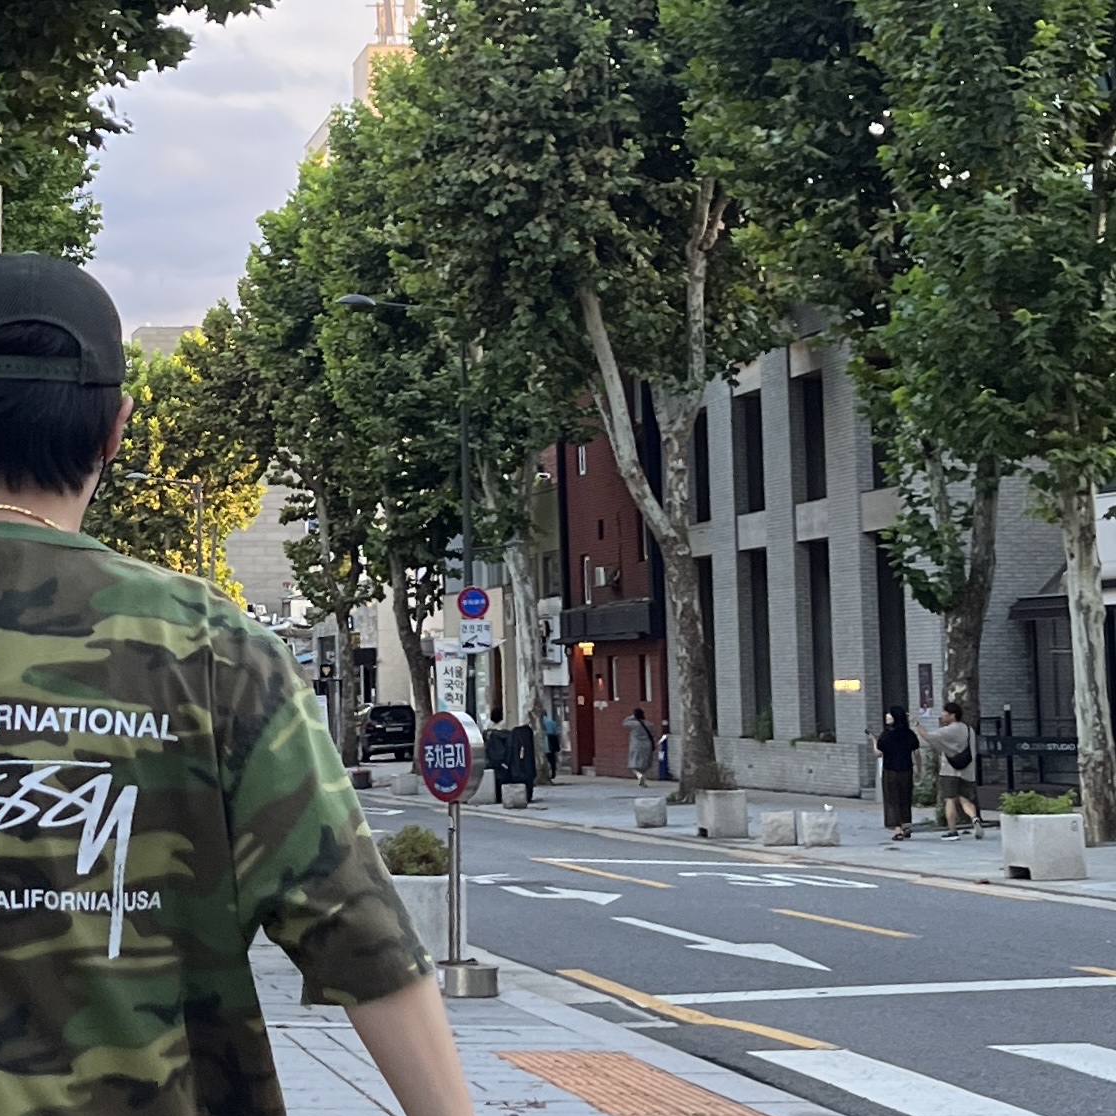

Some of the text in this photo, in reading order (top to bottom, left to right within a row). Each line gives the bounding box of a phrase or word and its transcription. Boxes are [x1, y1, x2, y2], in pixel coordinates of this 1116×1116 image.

[443, 665, 464, 679] 서울
[424, 743, 466, 769] 주차금지
[124, 890, 162, 912] USA
